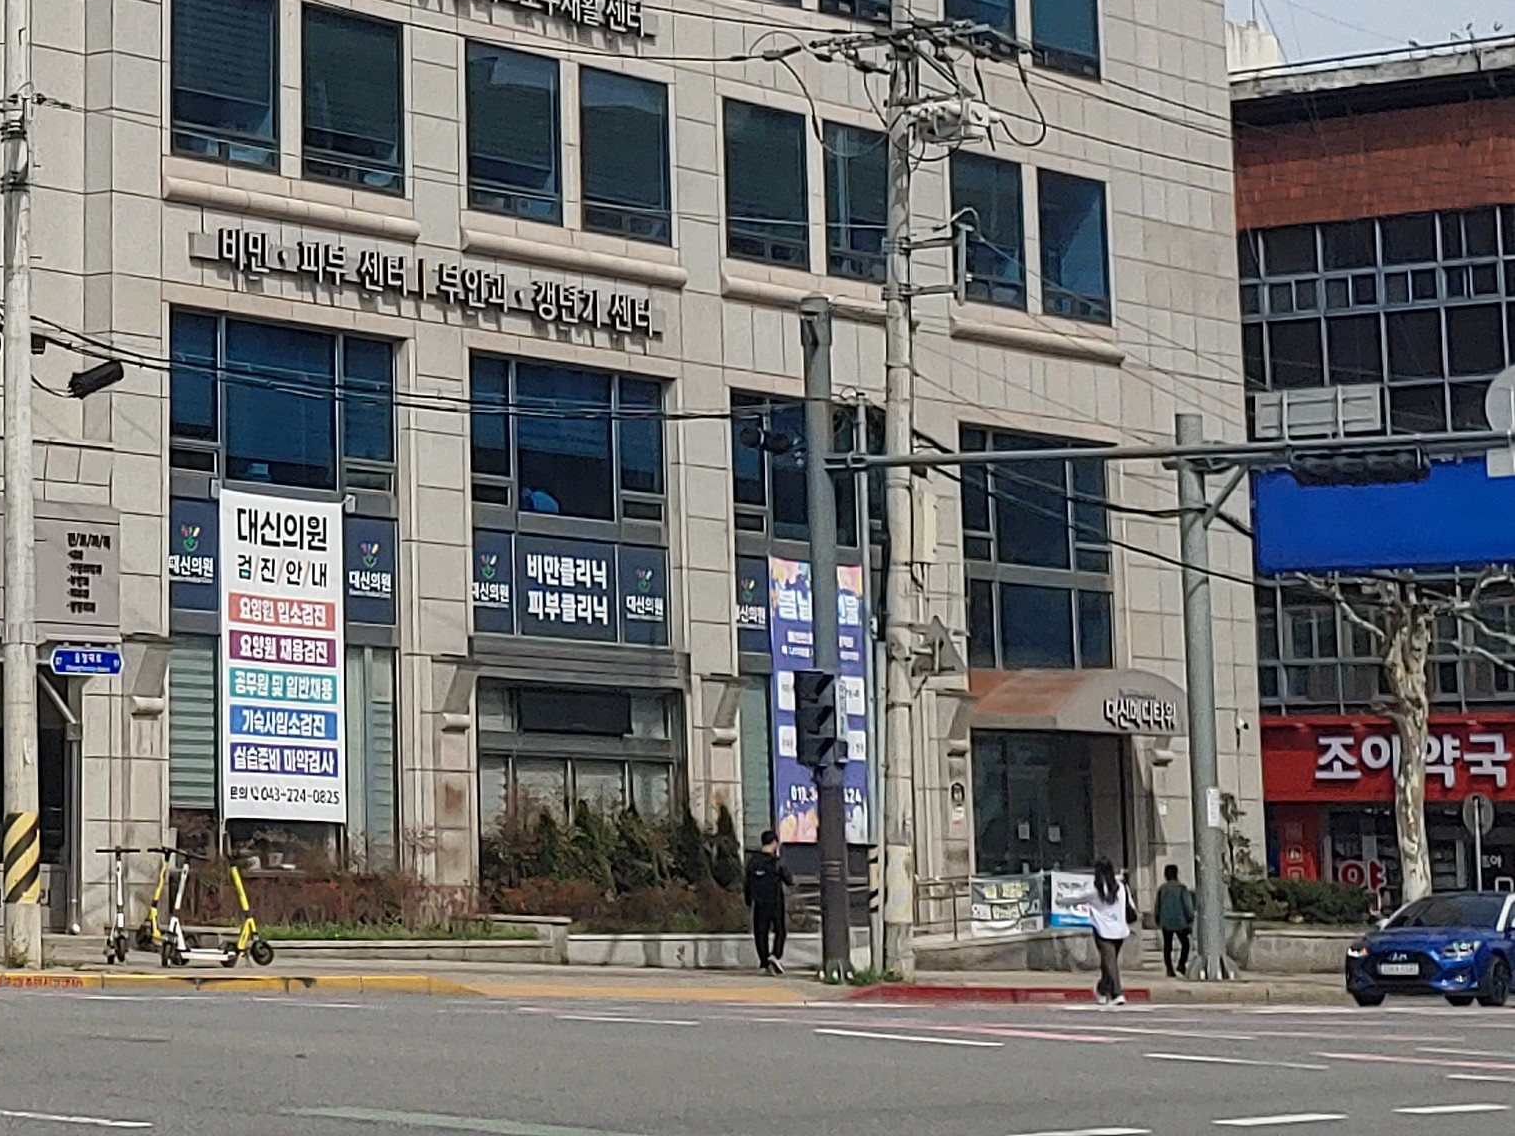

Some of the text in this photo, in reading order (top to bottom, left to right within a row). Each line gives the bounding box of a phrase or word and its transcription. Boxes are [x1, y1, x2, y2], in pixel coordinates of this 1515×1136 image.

[360, 250, 408, 298] 센터
[610, 293, 653, 338] 센터
[236, 507, 328, 552] 대신의원
[348, 570, 392, 592] 대신의원
[526, 553, 608, 590] 비만클리닉
[527, 590, 609, 626] 피부클리닉
[736, 604, 766, 624] 신의원
[240, 634, 328, 664] 요양원 채용검진
[233, 745, 335, 775] 실습준비 마약검사
[229, 785, 340, 805] 문의 043-224-0825
